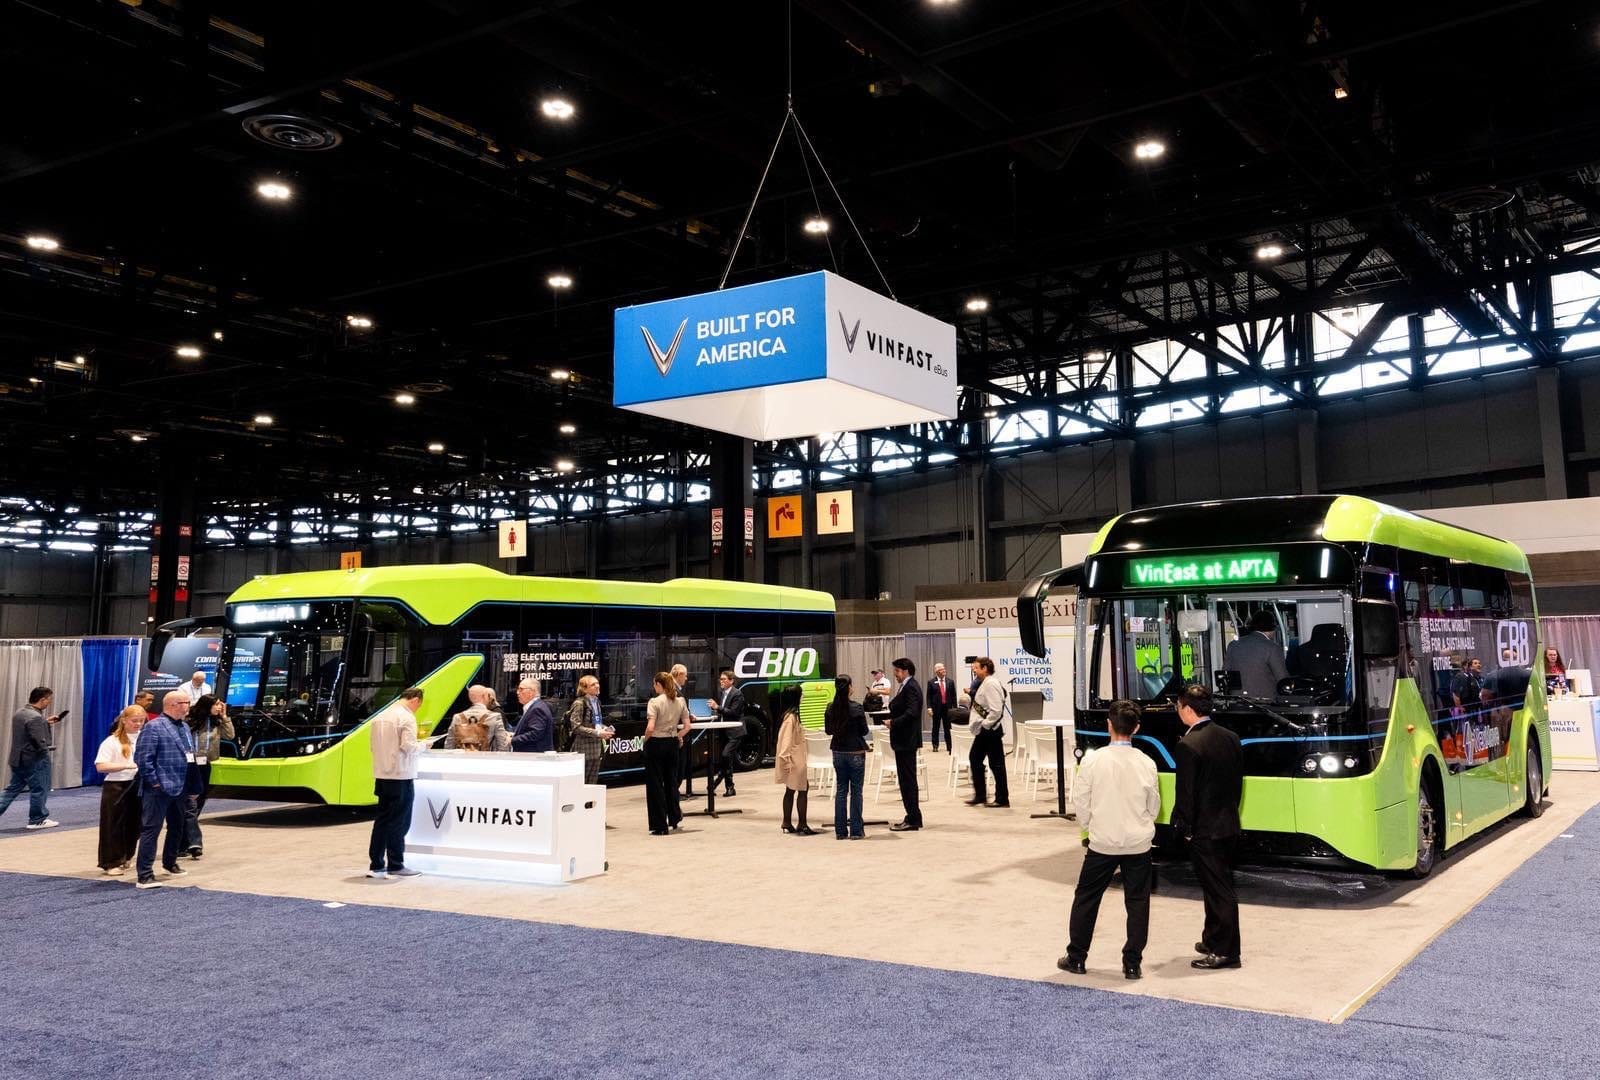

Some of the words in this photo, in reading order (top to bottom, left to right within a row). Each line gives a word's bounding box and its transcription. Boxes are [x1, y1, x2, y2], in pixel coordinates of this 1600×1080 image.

[697, 314, 750, 339] BUILT
[755, 307, 796, 330] FOR
[696, 337, 787, 366] AMERICA
[867, 330, 933, 371] VINFAST
[934, 365, 948, 377] eBus
[1203, 561, 1224, 579] at
[1228, 558, 1279, 578] APTA
[925, 604, 1018, 624] Emergenc
[1497, 620, 1530, 668] EB8
[520, 662, 536, 671] FOR
[538, 662, 545, 670] A
[547, 661, 599, 670] SUSTAINABLE
[521, 653, 557, 661] ELECTRIC
[560, 652, 595, 660] MOBILITY
[733, 647, 817, 678] EB10
[1010, 657, 1052, 665] VIETNAM.
[520, 672, 553, 680] FUTURE.
[1009, 667, 1032, 675] BUILT
[1034, 667, 1052, 675] FOR
[609, 736, 646, 754] NexM
[456, 806, 536, 827] VINFAST
